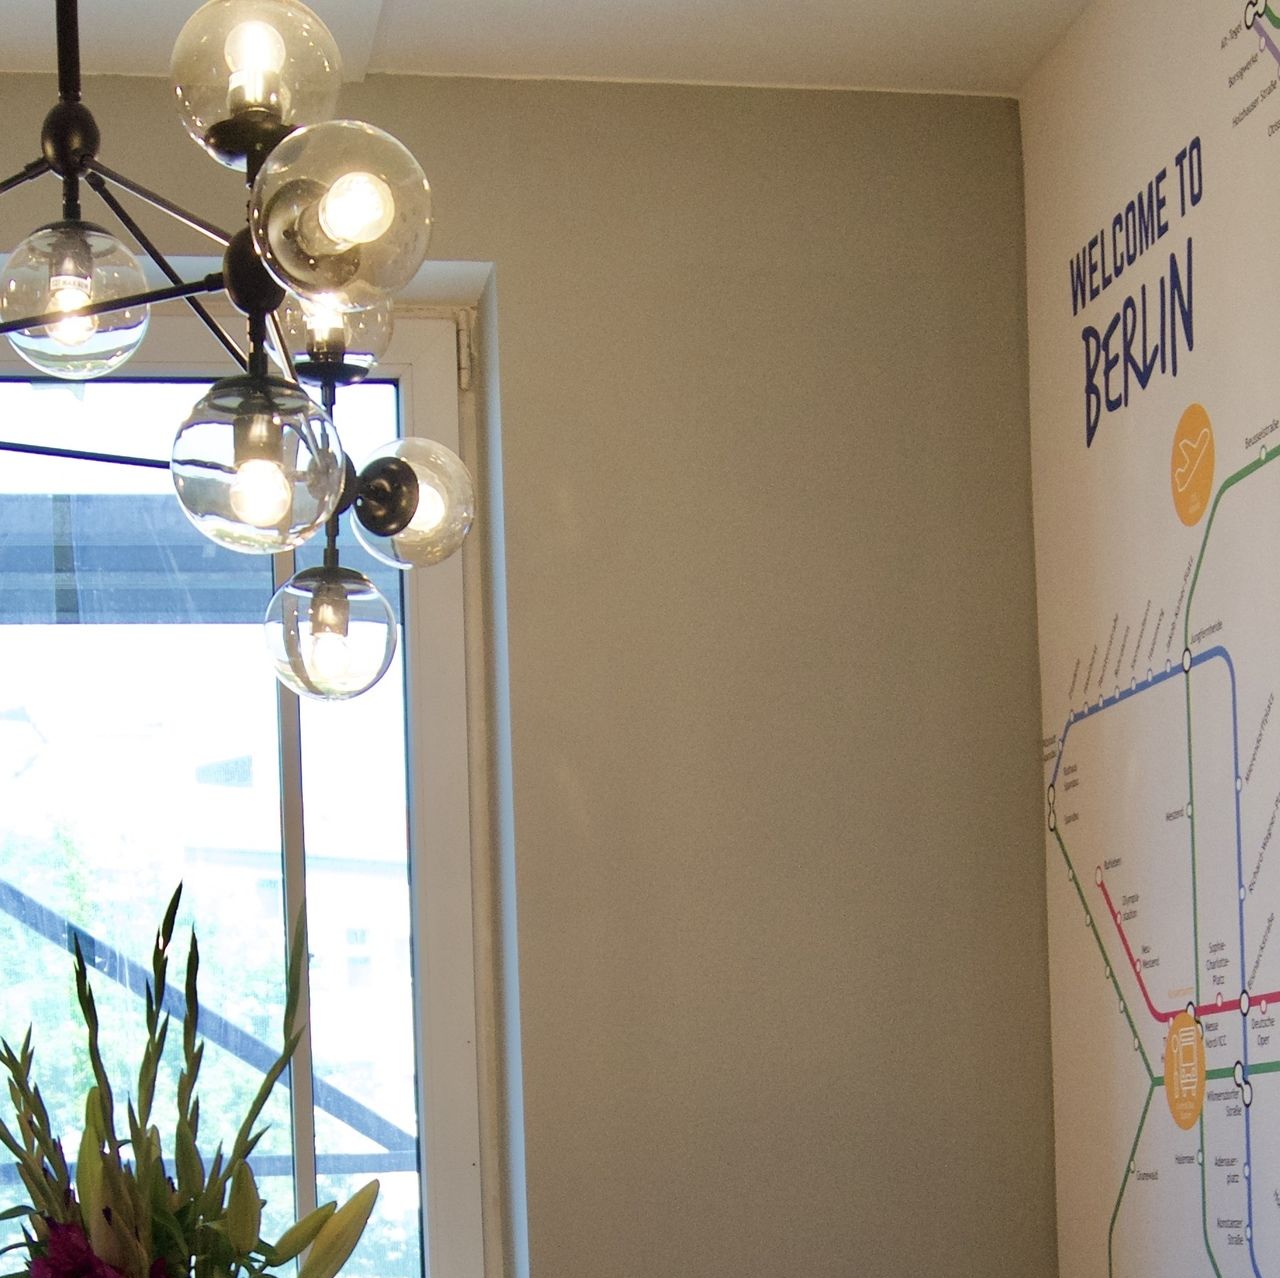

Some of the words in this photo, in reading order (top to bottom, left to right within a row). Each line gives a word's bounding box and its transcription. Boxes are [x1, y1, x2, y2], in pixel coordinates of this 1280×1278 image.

[1069, 167, 1170, 317] WELCOME
[1176, 136, 1203, 218] TO
[1082, 237, 1193, 449] BERLIN
